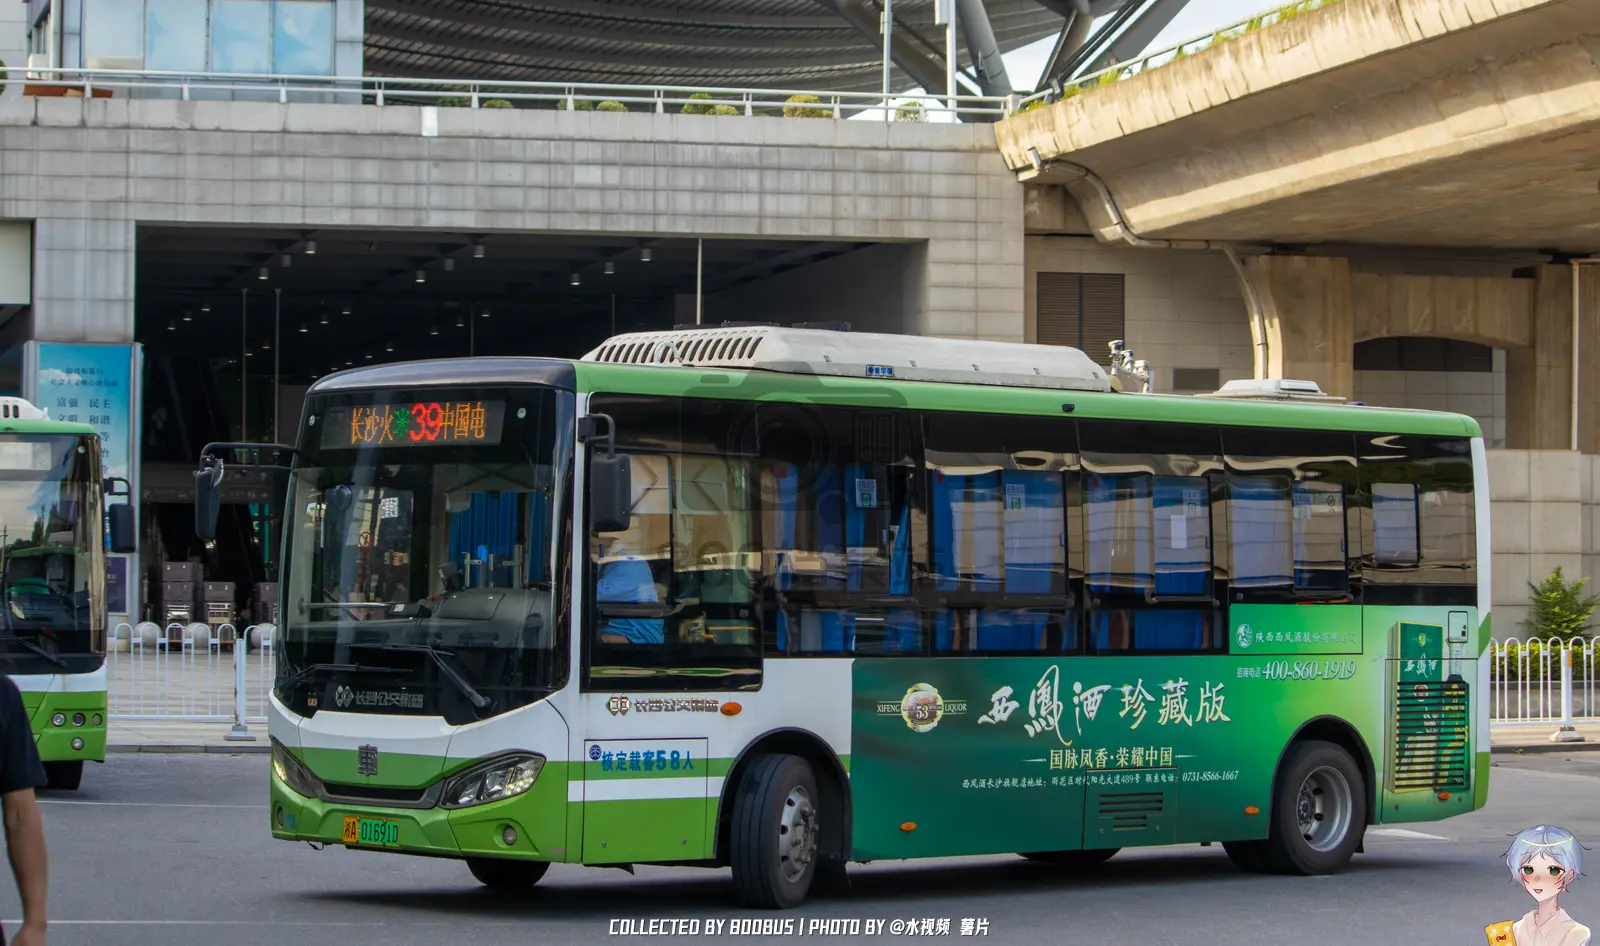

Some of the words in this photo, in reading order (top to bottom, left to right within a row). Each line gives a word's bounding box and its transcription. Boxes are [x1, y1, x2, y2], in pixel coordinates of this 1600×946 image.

[89, 398, 111, 408] 民主
[1236, 666, 1261, 679] 招商电话
[1262, 660, 1357, 680] 400-860-1919
[876, 704, 900, 713] XIFENG
[944, 703, 967, 713] LIQUOR
[916, 704, 929, 720] 53
[601, 749, 694, 772] 核定载客58人
[1182, 770, 1239, 782] 0731-8566-1667
[361, 822, 399, 844] 01691D
